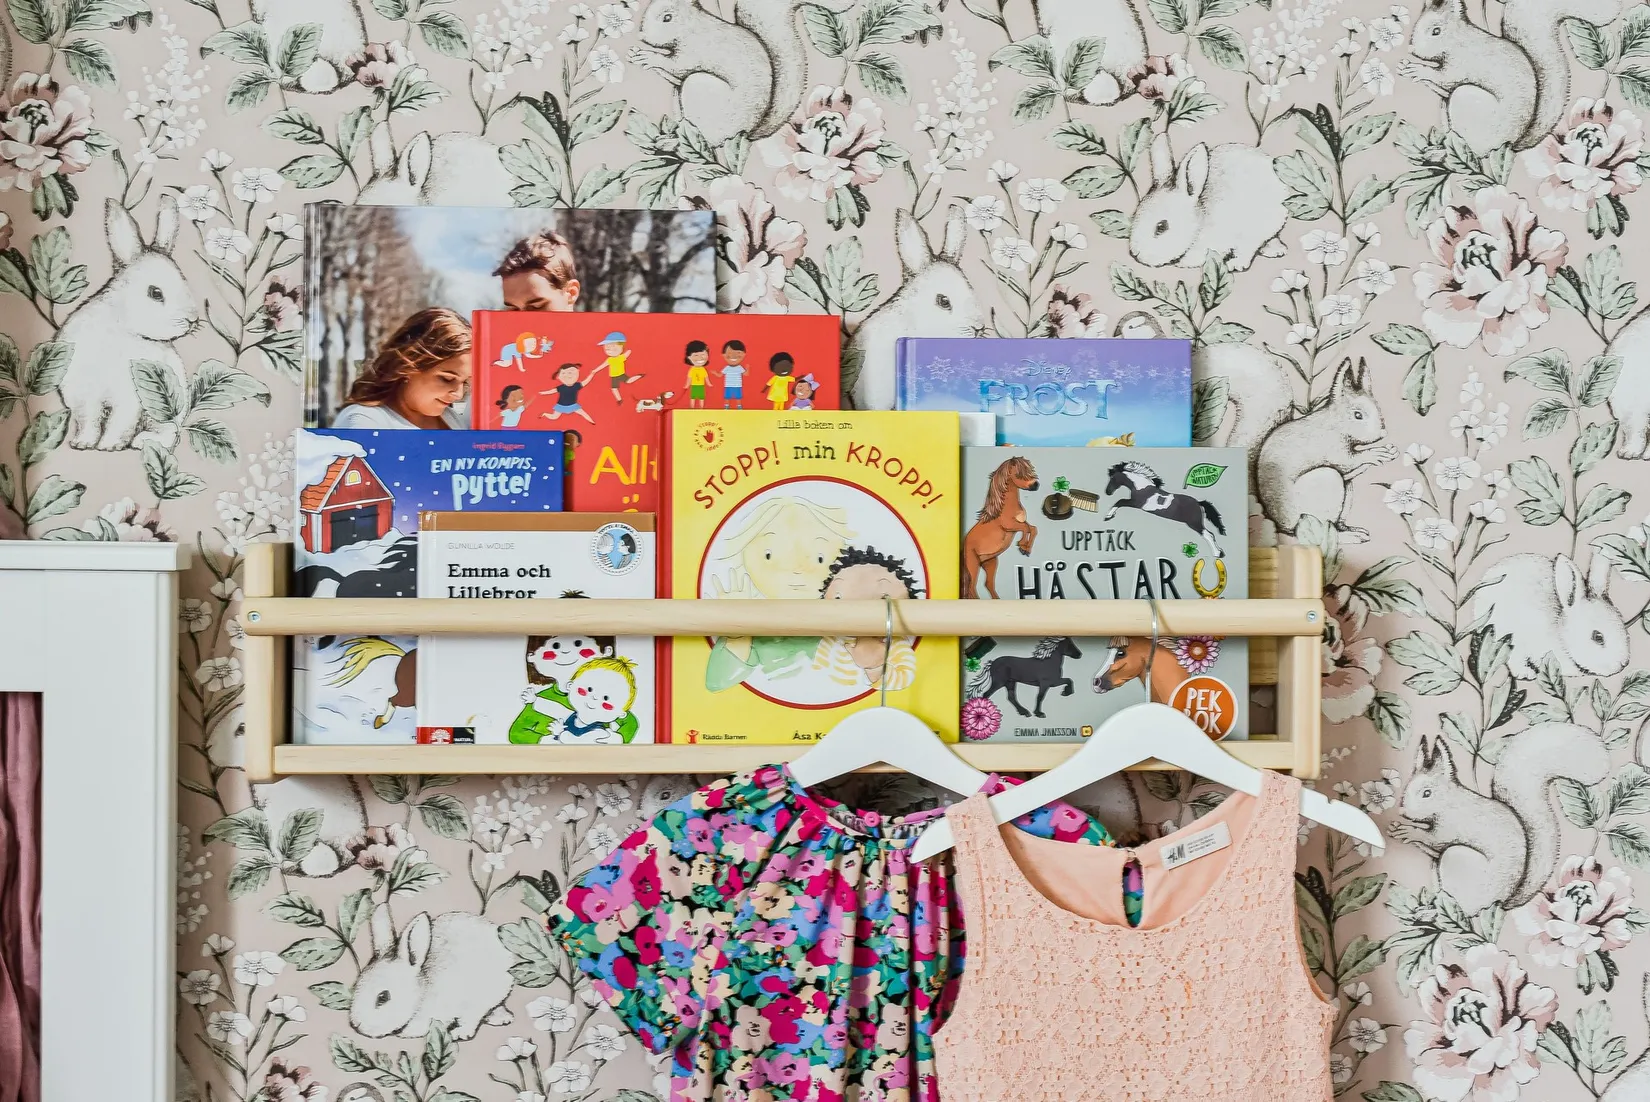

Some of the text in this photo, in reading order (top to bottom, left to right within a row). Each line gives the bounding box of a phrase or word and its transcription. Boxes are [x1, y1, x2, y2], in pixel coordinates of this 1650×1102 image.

[1020, 358, 1073, 380] Disney
[977, 377, 1118, 420] FROST
[777, 419, 853, 430] Lilla boken om
[430, 456, 538, 474] EN NY KOMPIS,
[694, 440, 943, 509] STOPP! min KROPP!
[451, 471, 532, 512] pytte!
[447, 542, 516, 550] GUNILLA WOLDE
[1061, 529, 1137, 552] UPPTÄCK
[447, 563, 552, 578] Emma och
[1014, 556, 1183, 600] HÄSTAR
[447, 585, 538, 599] Lillebror
[1185, 687, 1223, 713] PEK
[792, 730, 812, 741] Åsa
[1014, 727, 1078, 737] EMMA JANSSON
